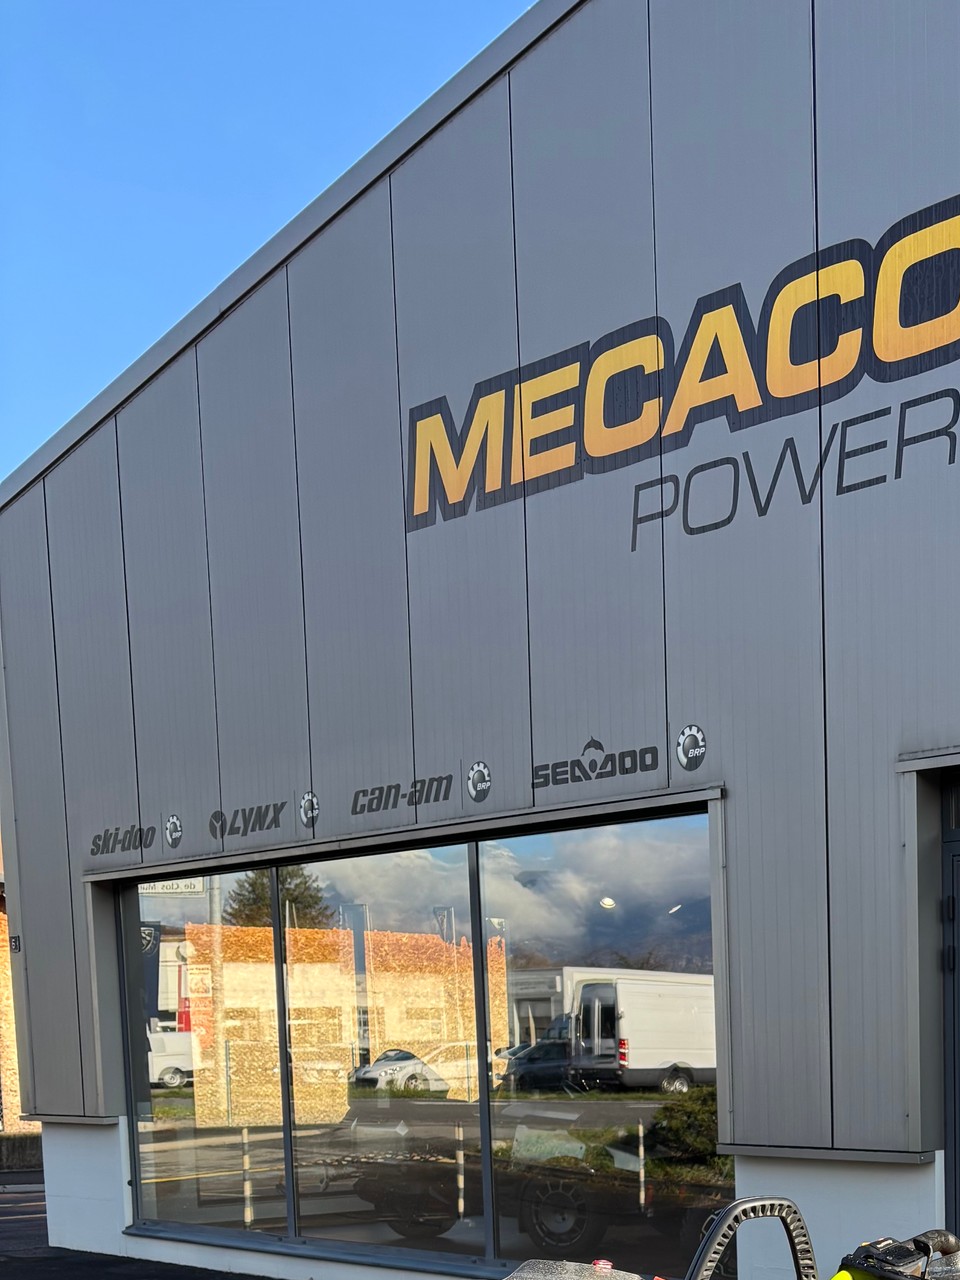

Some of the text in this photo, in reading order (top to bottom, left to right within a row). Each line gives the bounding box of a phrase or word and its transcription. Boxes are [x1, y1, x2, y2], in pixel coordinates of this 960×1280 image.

[630, 388, 960, 552] POWER
[686, 745, 706, 758] BRP
[350, 773, 453, 816] can-am
[476, 779, 491, 791] BRP
[226, 801, 288, 837] LYNX
[90, 824, 157, 857] ski-doo
